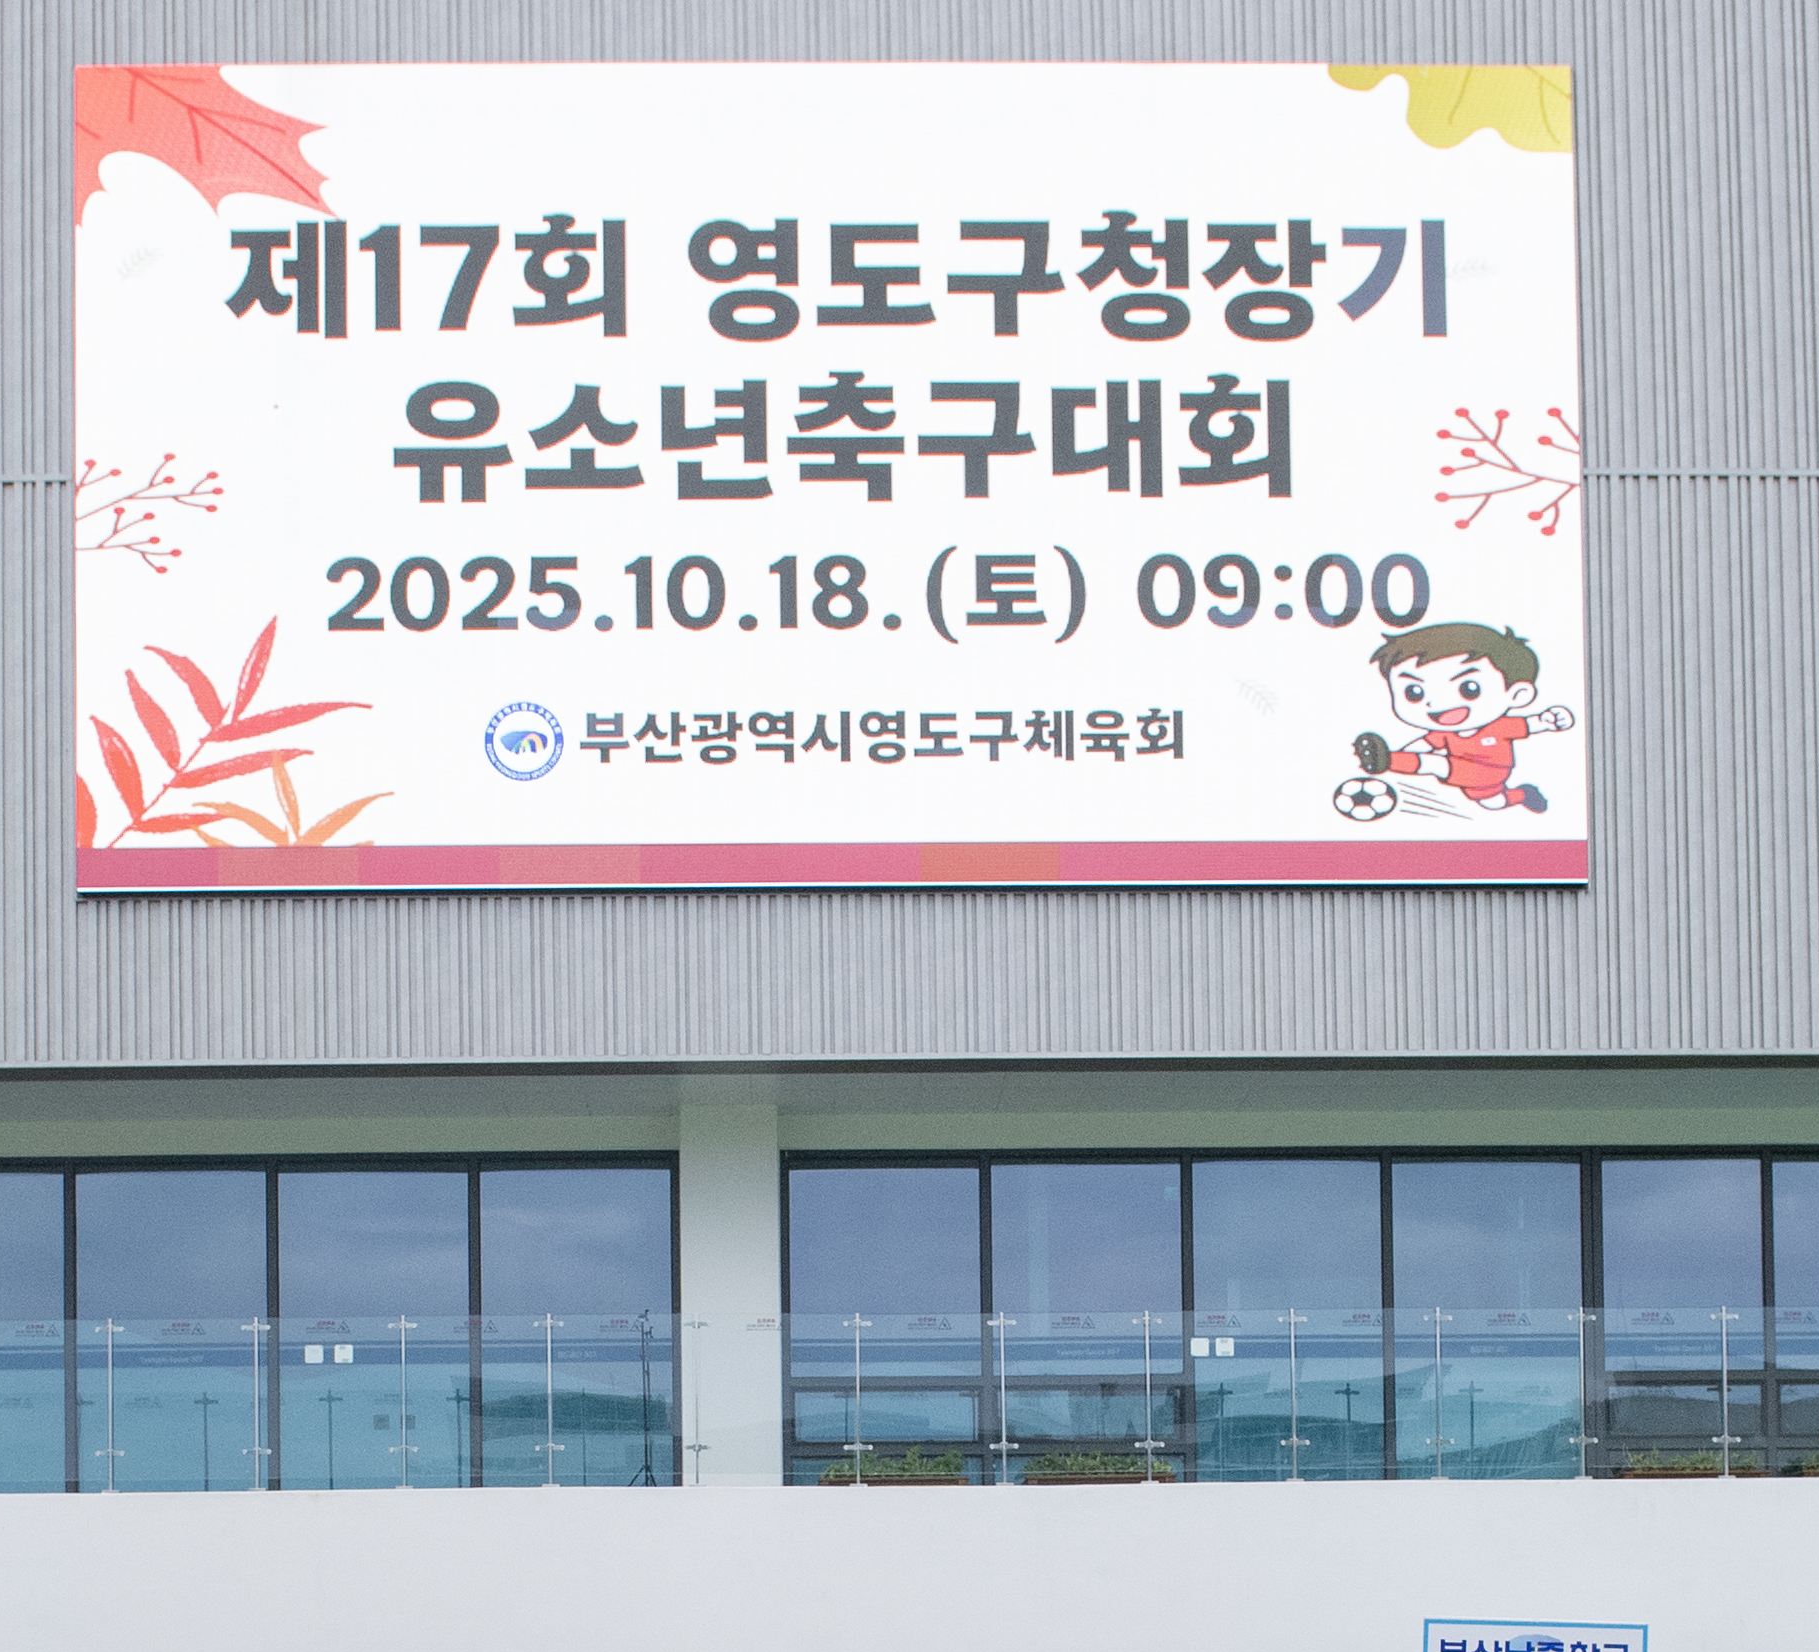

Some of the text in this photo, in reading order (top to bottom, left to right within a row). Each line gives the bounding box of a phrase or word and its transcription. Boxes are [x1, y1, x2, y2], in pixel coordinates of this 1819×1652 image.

[225, 209, 1448, 343] 제17회 영도구청장기
[392, 371, 1293, 504] 유소년축구대회
[325, 544, 1432, 645] 2025.10.18.(토) 09:00
[579, 708, 1187, 766] 부산광역시영도구체육회
